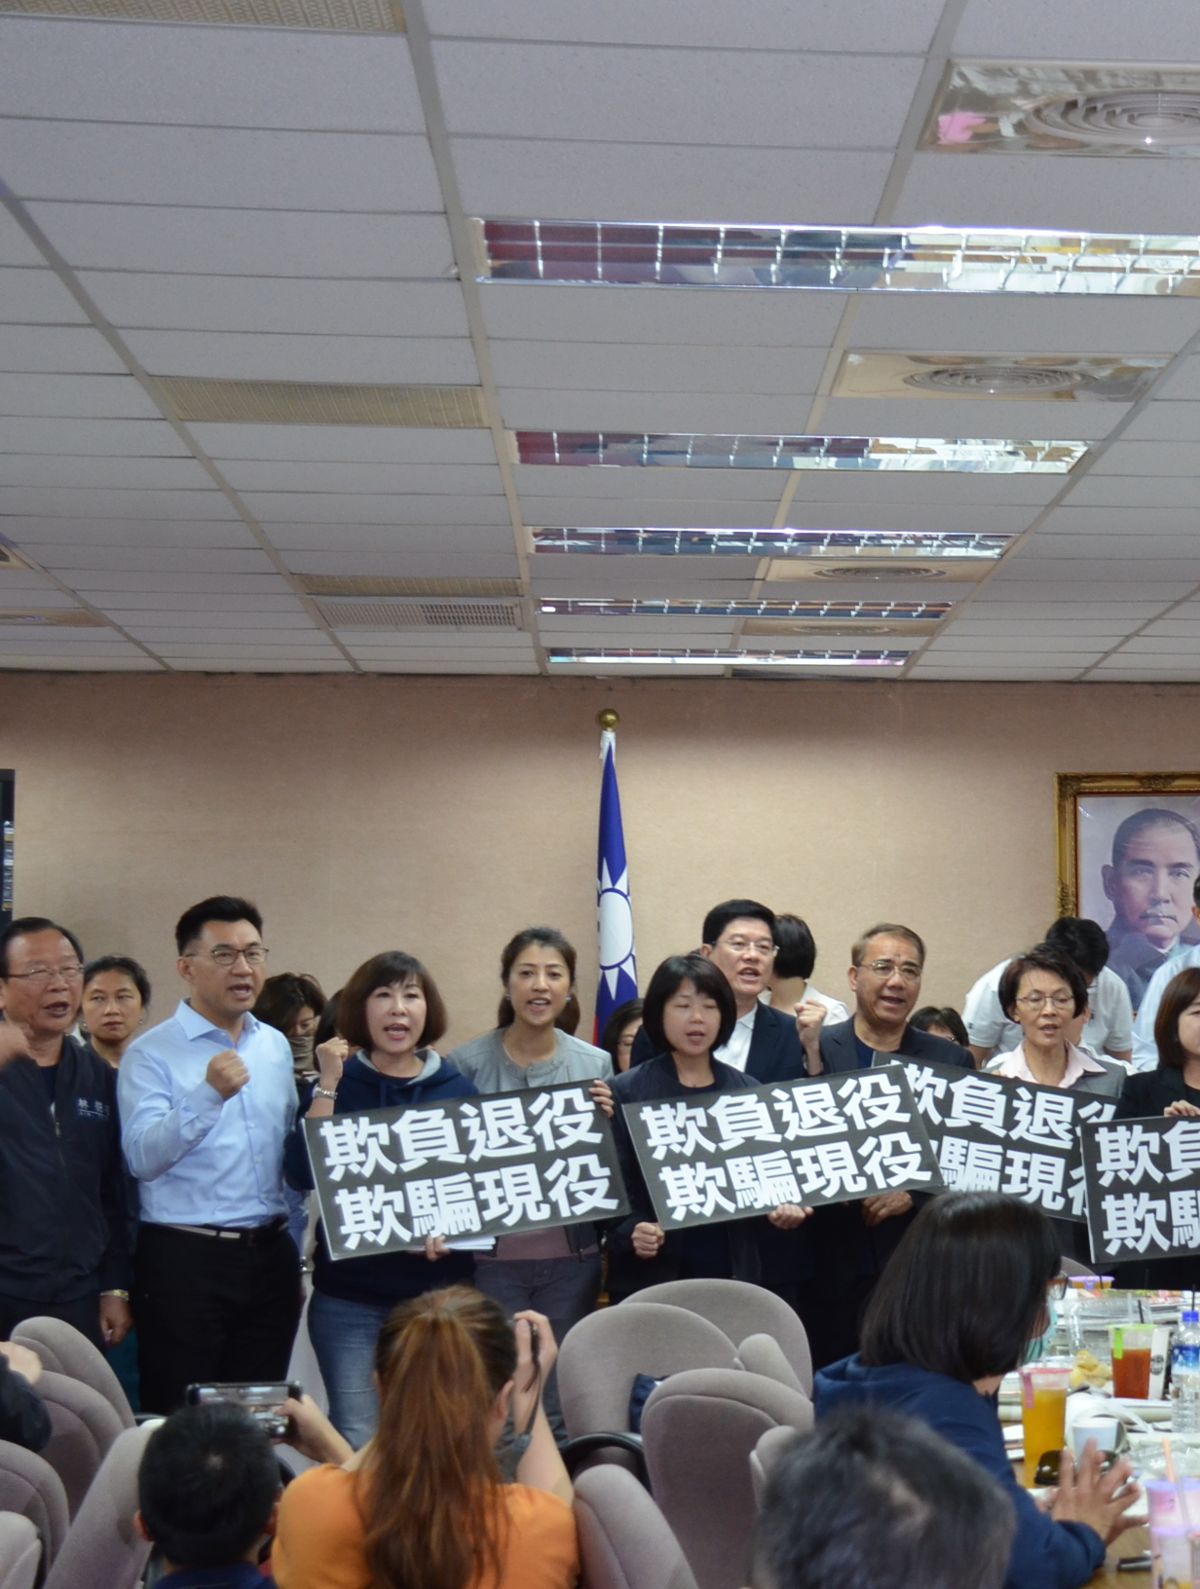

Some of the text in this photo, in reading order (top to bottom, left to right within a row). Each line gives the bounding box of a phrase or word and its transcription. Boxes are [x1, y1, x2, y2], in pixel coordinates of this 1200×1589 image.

[320, 1087, 604, 1182] 欺負退役
[640, 1074, 912, 1161] 欺負退役
[334, 1153, 620, 1250] 欺騙現役
[659, 1131, 932, 1221] 欺騙現役
[930, 1136, 1087, 1216] 騙現
